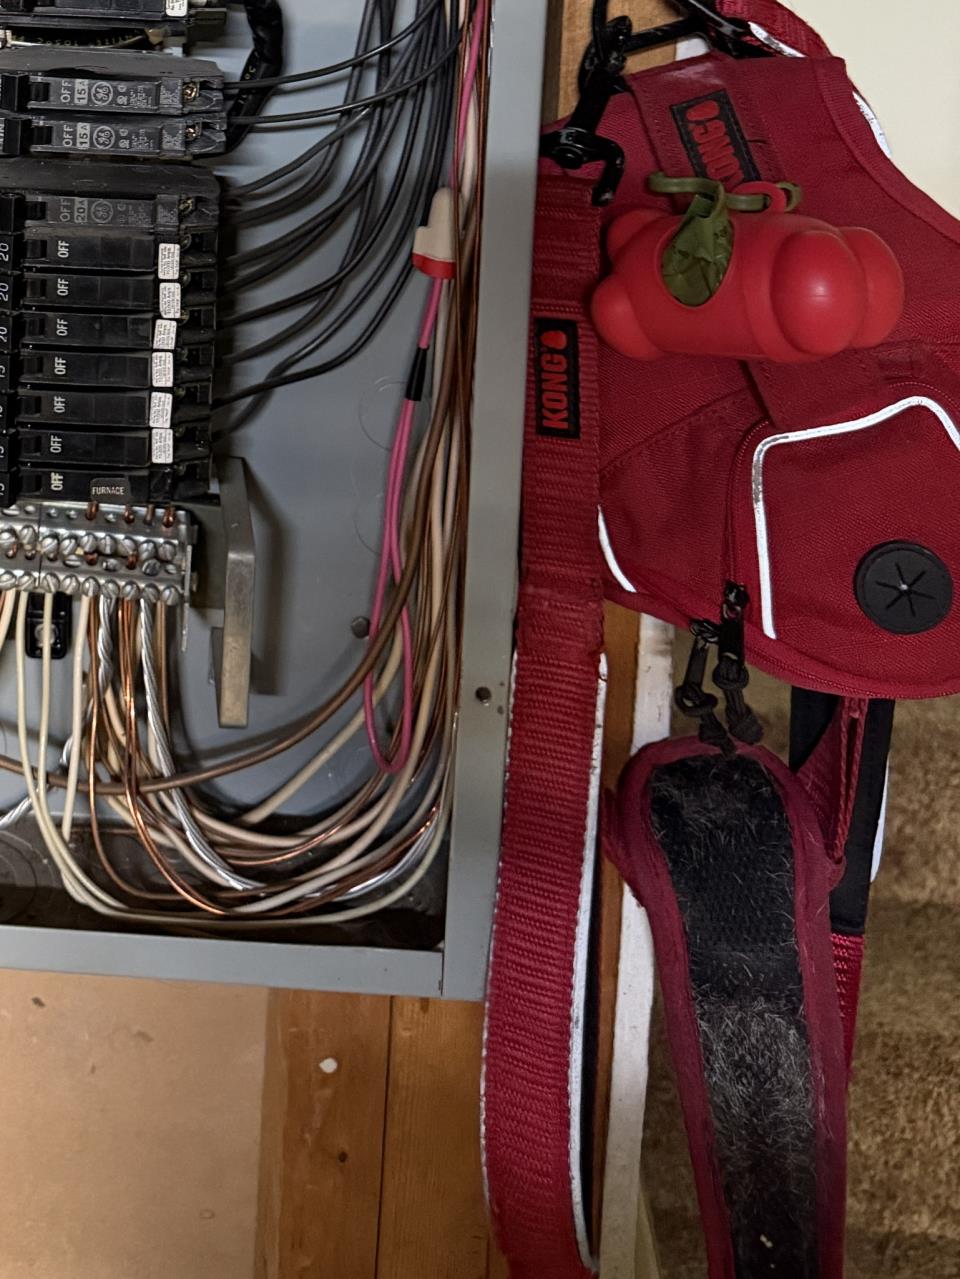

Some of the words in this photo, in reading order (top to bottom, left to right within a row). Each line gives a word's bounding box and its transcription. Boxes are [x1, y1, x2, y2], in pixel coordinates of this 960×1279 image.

[60, 80, 73, 103] OFF
[62, 124, 74, 148] OFF
[59, 199, 71, 222] OFF
[57, 240, 69, 258] OFF
[56, 278, 69, 296] OFF
[56, 318, 68, 336] OFF
[54, 356, 66, 375] OFF
[540, 352, 569, 430] KONG
[53, 395, 66, 413] OFF
[50, 434, 62, 454] OFF
[50, 472, 64, 491] OFF
[91, 486, 125, 496] FURNACE
